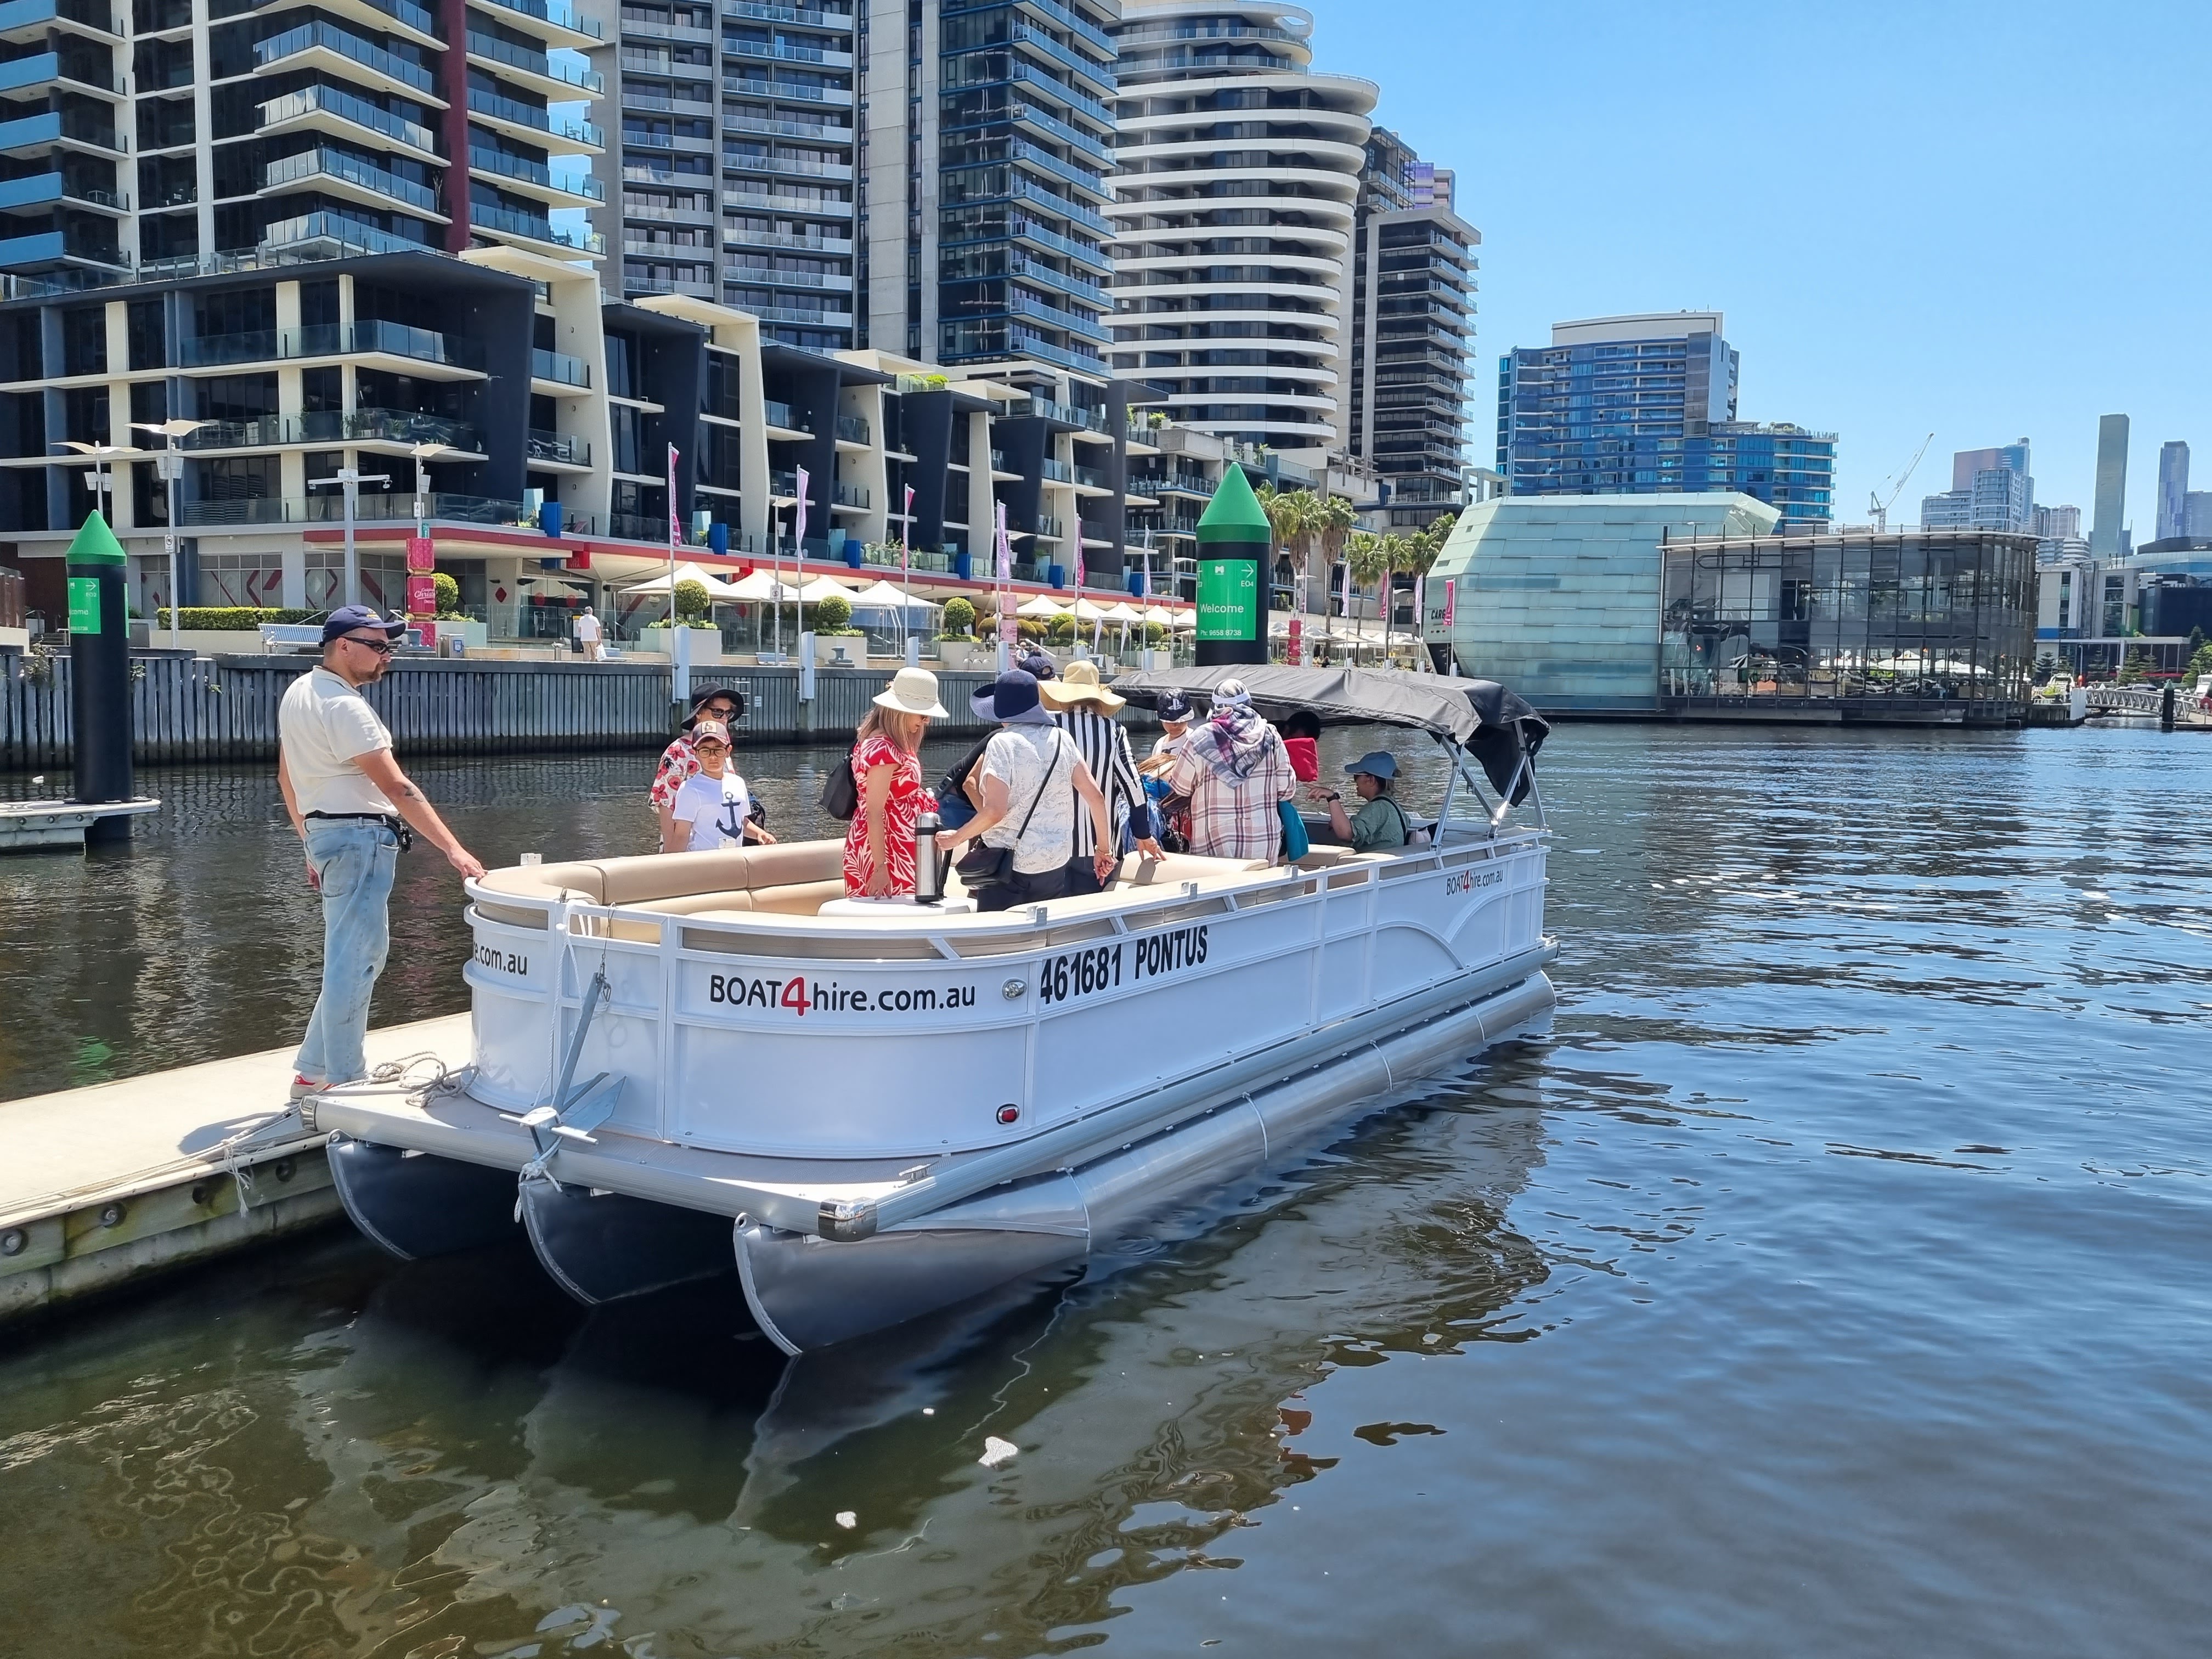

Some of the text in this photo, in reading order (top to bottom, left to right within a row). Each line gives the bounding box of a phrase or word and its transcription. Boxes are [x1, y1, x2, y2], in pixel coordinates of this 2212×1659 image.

[1200, 603, 1244, 613] Welcome
[1431, 609, 1446, 620] CARG
[1446, 870, 1503, 895] BOAT4hire.com.au
[1040, 925, 1208, 1005] 461681 PONTUS
[710, 974, 975, 1016] BOAT4hire.com.au
